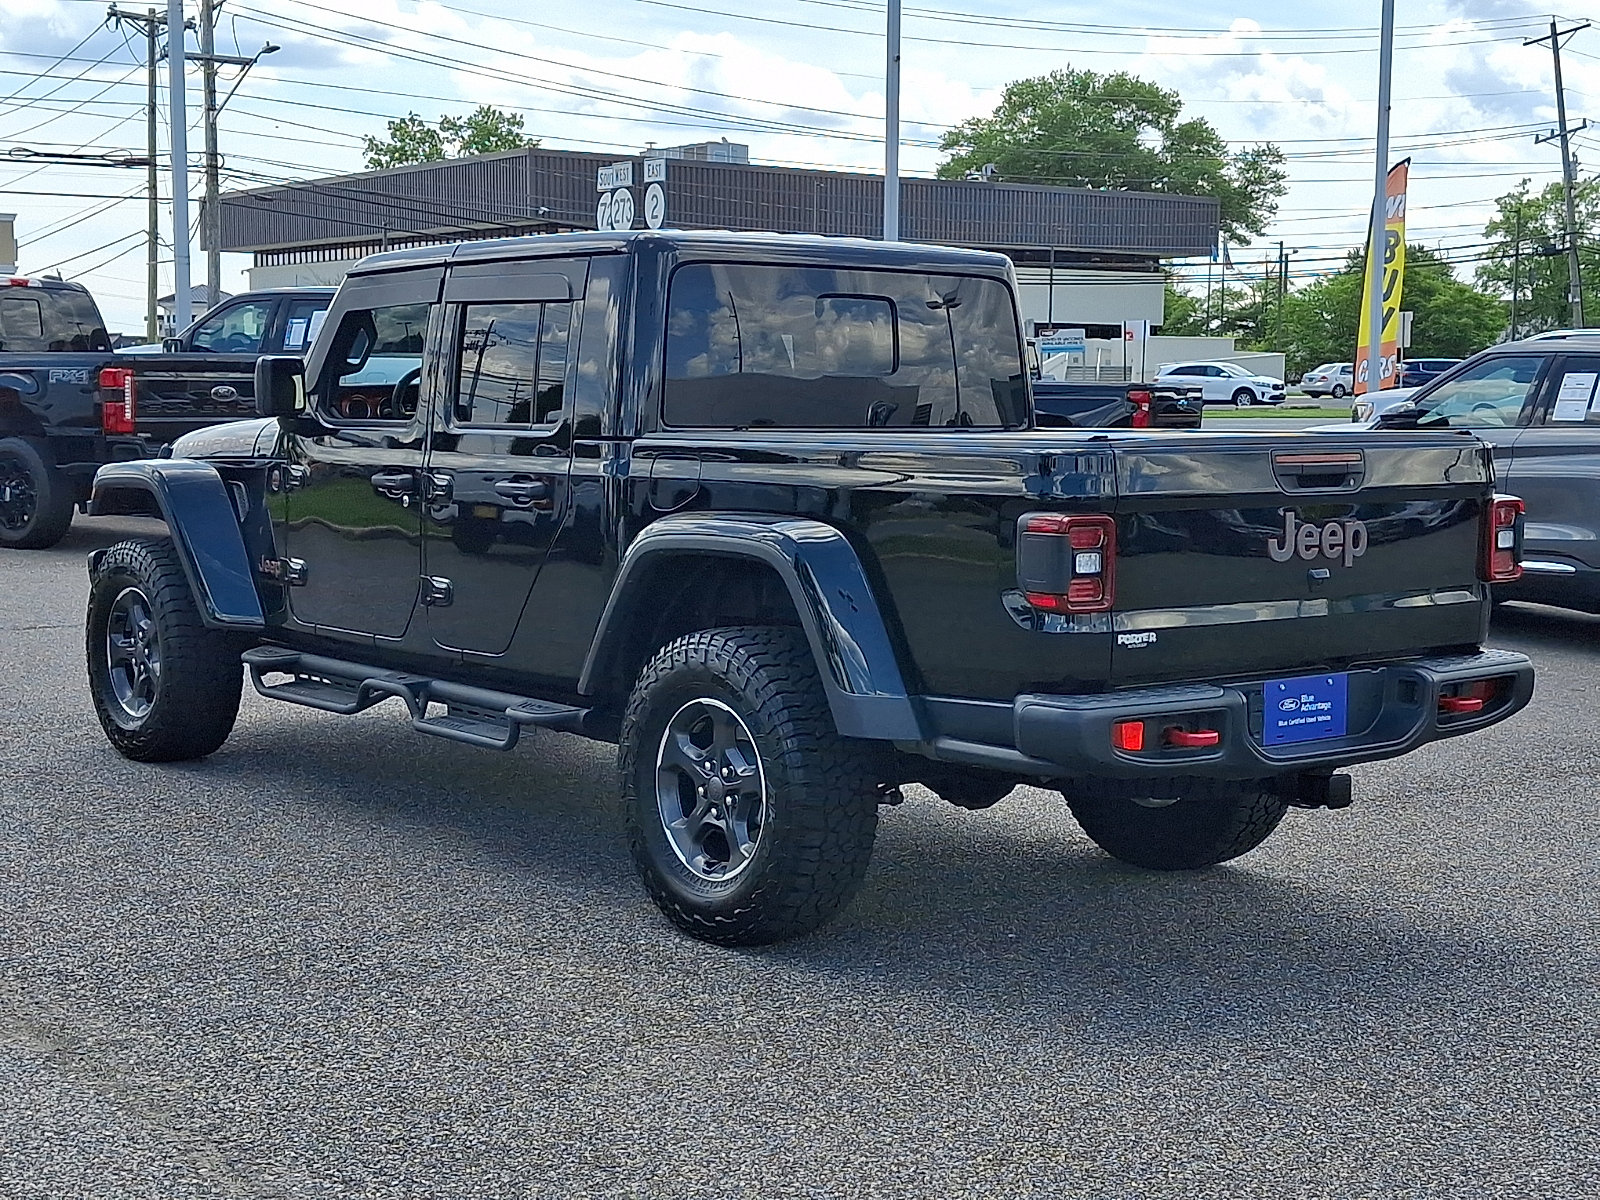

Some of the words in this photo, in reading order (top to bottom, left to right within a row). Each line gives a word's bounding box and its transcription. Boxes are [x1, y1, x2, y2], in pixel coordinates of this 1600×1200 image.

[614, 167, 630, 182] WEST
[647, 163, 661, 178] EAST
[599, 172, 613, 186] SOU
[613, 197, 632, 224] 273
[651, 194, 659, 220] 2
[1358, 354, 1396, 383] CRS
[49, 369, 88, 384] FX4
[1267, 511, 1368, 567] Jeep
[258, 554, 281, 578] Jeep
[1117, 632, 1157, 645] PORTER
[1301, 694, 1315, 703] Blue
[1300, 702, 1332, 712] Advantage
